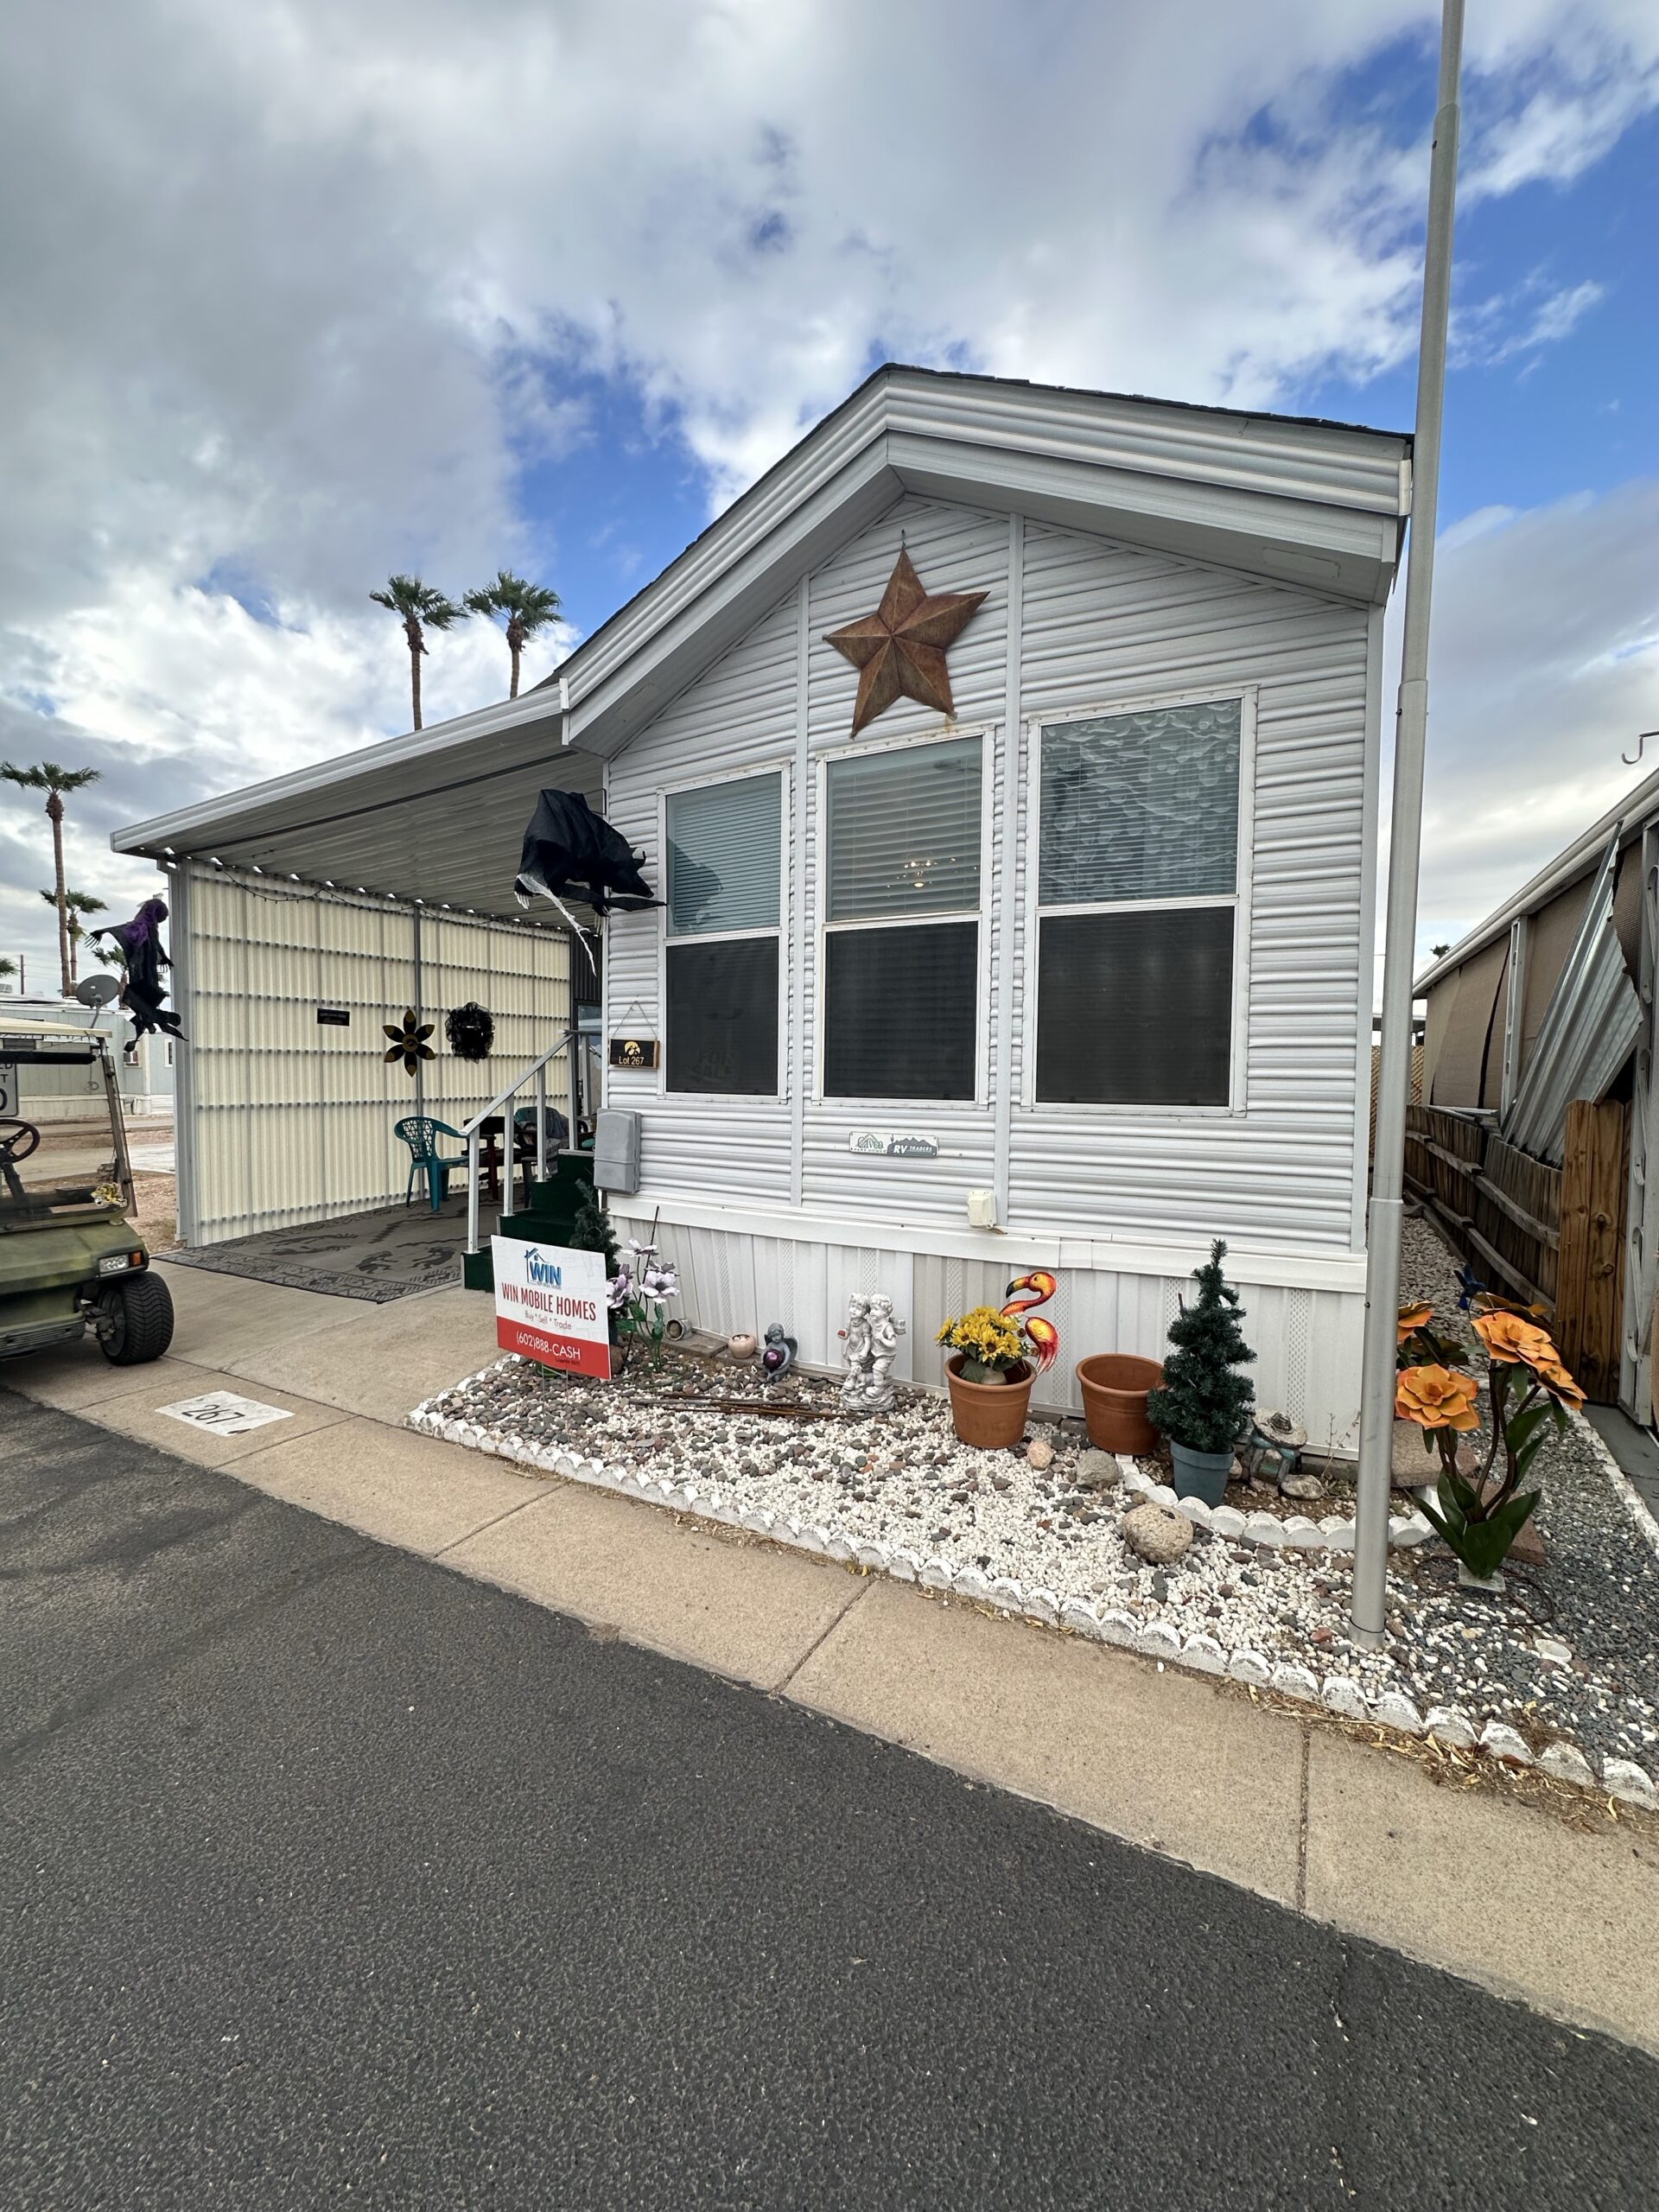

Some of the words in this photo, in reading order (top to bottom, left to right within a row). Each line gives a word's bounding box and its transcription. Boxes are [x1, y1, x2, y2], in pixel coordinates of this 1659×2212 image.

[619, 1056, 630, 1065] Lot
[631, 1056, 645, 1065] 267
[893, 1144, 908, 1154] RV
[530, 1262, 562, 1286] WIN
[502, 1281, 518, 1303] WIN
[521, 1287, 554, 1313] MOBILE
[556, 1296, 596, 1321] HOMES
[525, 1310, 534, 1321] Buy
[538, 1313, 548, 1325] Sell
[554, 1318, 572, 1330] Trade
